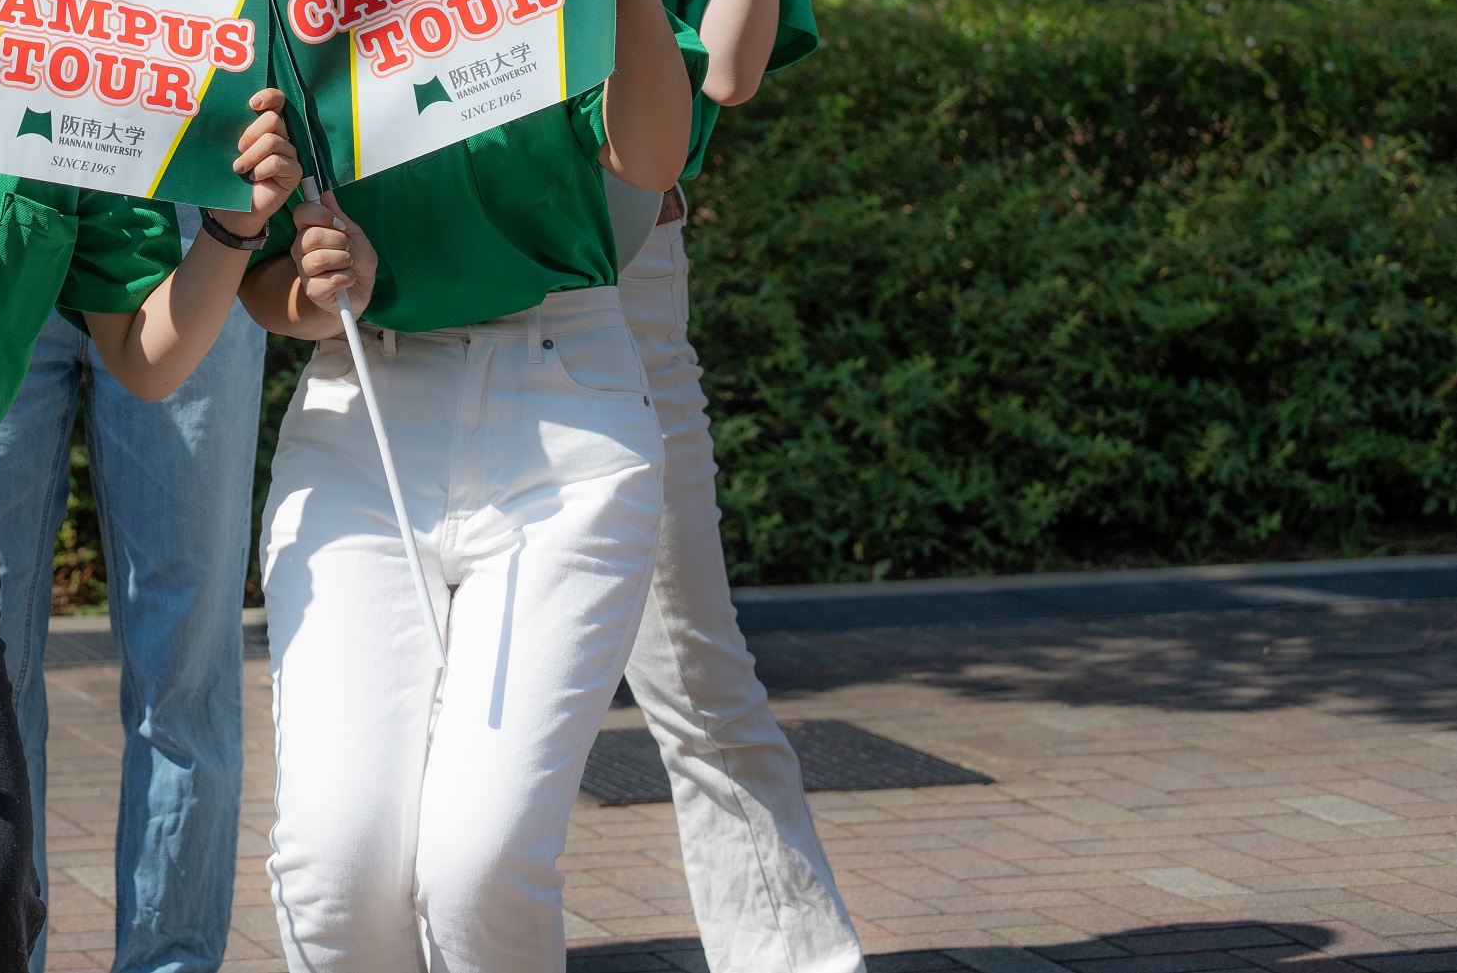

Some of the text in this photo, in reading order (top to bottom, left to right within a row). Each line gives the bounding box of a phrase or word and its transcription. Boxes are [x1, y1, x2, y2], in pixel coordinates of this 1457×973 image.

[0, 36, 196, 114] TOUR
[447, 42, 532, 90] 阪南大学
[456, 61, 538, 100] HANNAN UNIVERSITY
[460, 89, 523, 122] SINCE 1965
[59, 114, 146, 146] 阪南大学
[58, 136, 144, 158] HANNAN UNIVERSITY
[51, 155, 117, 176] SINCE 1965
